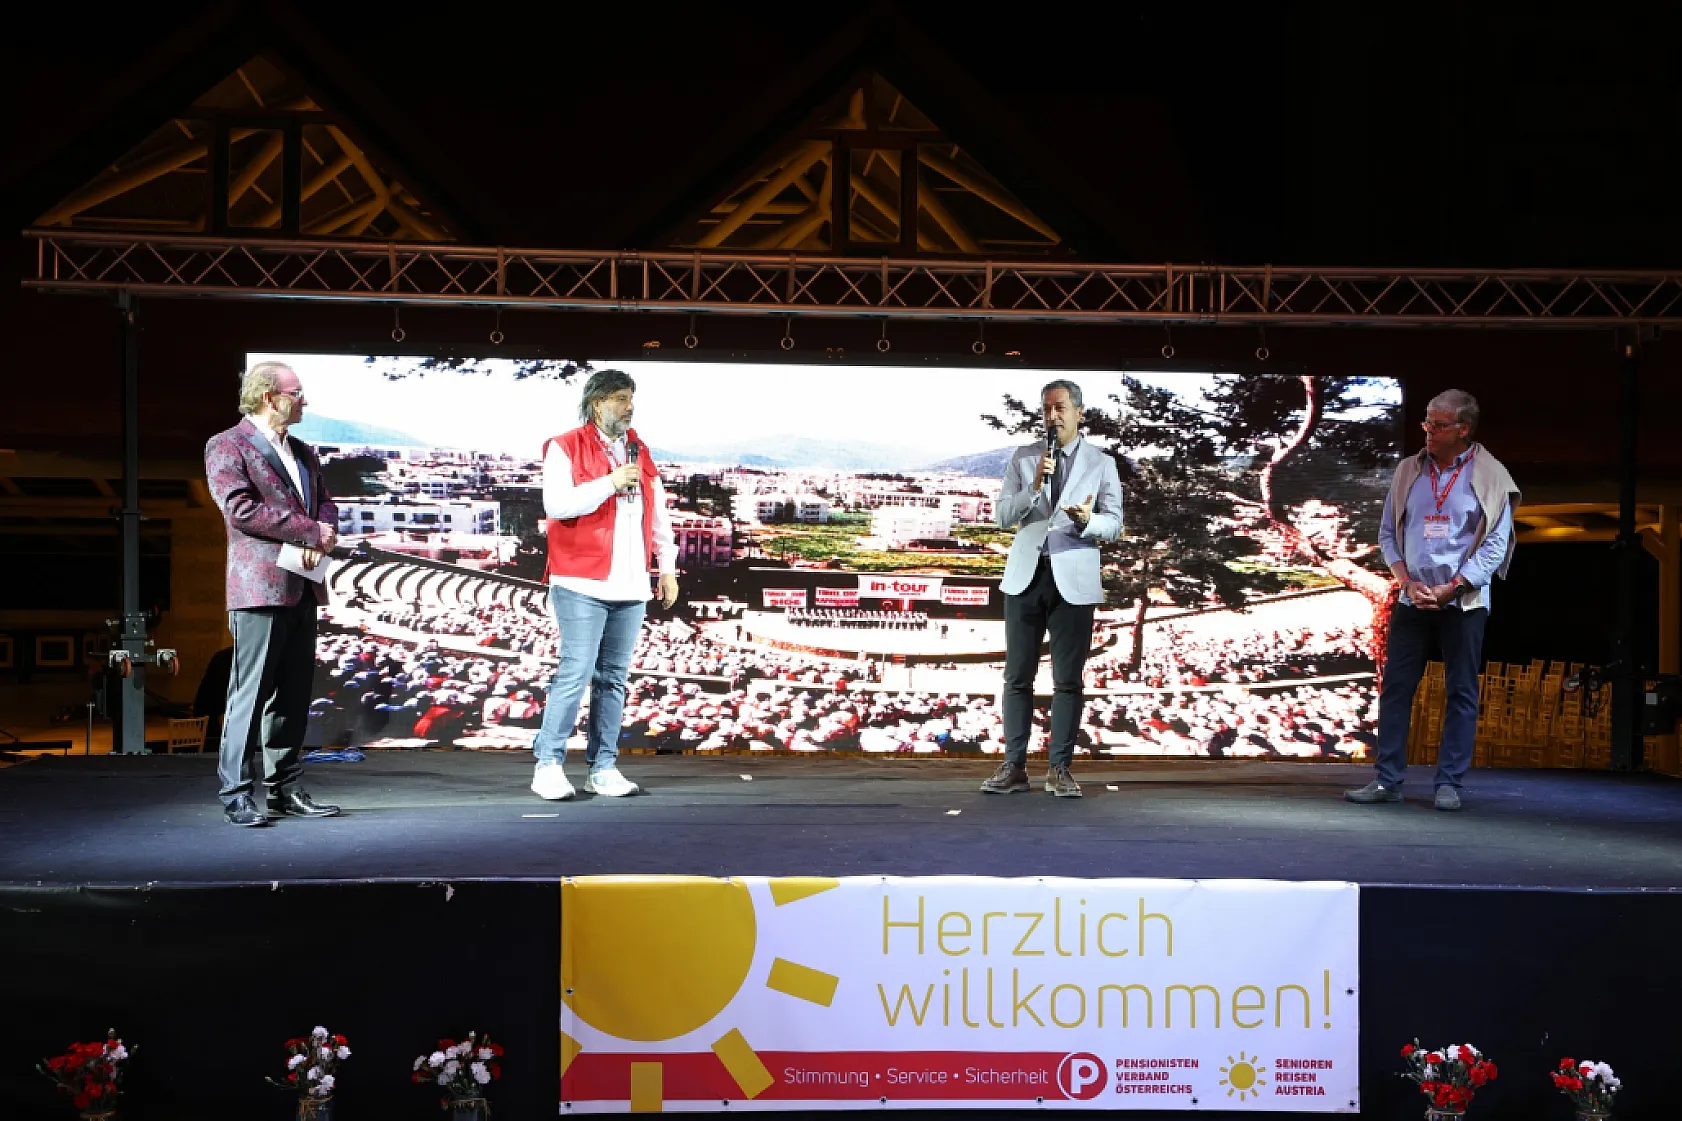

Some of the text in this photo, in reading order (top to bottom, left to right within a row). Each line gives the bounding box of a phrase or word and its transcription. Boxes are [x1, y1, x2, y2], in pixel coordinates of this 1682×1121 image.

[870, 580, 928, 593] in-tour
[882, 895, 1174, 958] Herzlich
[877, 967, 1332, 1030] willkommen!
[1116, 1058, 1199, 1068] PENSIONISTEN
[1276, 1058, 1333, 1069] SENIOREN
[784, 1067, 1049, 1088] Stimmung Service Sicherheit
[1070, 1058, 1100, 1094] P
[1116, 1071, 1170, 1081] VERBAND
[1276, 1072, 1317, 1082] REISEN
[1116, 1083, 1193, 1094] ÖSTERREICHS
[1276, 1085, 1325, 1096] AUSTRIA
